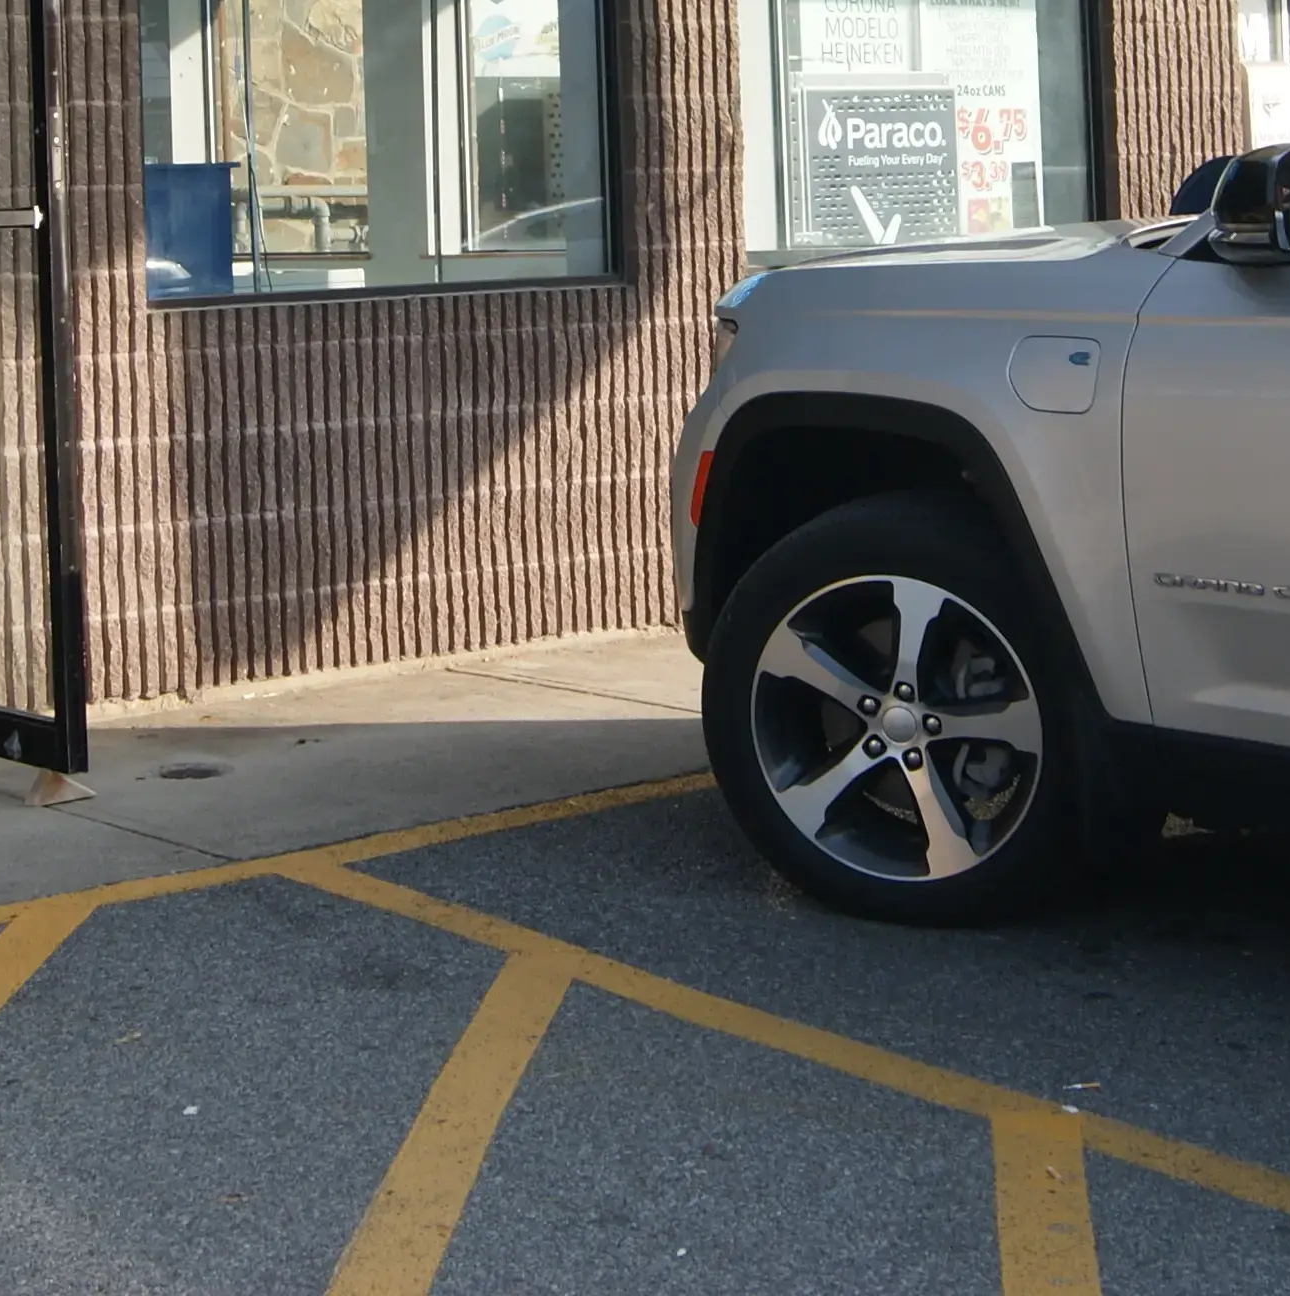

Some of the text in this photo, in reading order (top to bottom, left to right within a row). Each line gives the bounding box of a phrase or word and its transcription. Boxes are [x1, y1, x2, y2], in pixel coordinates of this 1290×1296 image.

[825, 17, 899, 40] MODELO
[821, 42, 903, 65] HEINEKEN
[957, 85, 1006, 97] 24oz CANS
[957, 106, 1027, 154] $6.75
[880, 154, 900, 166] Your
